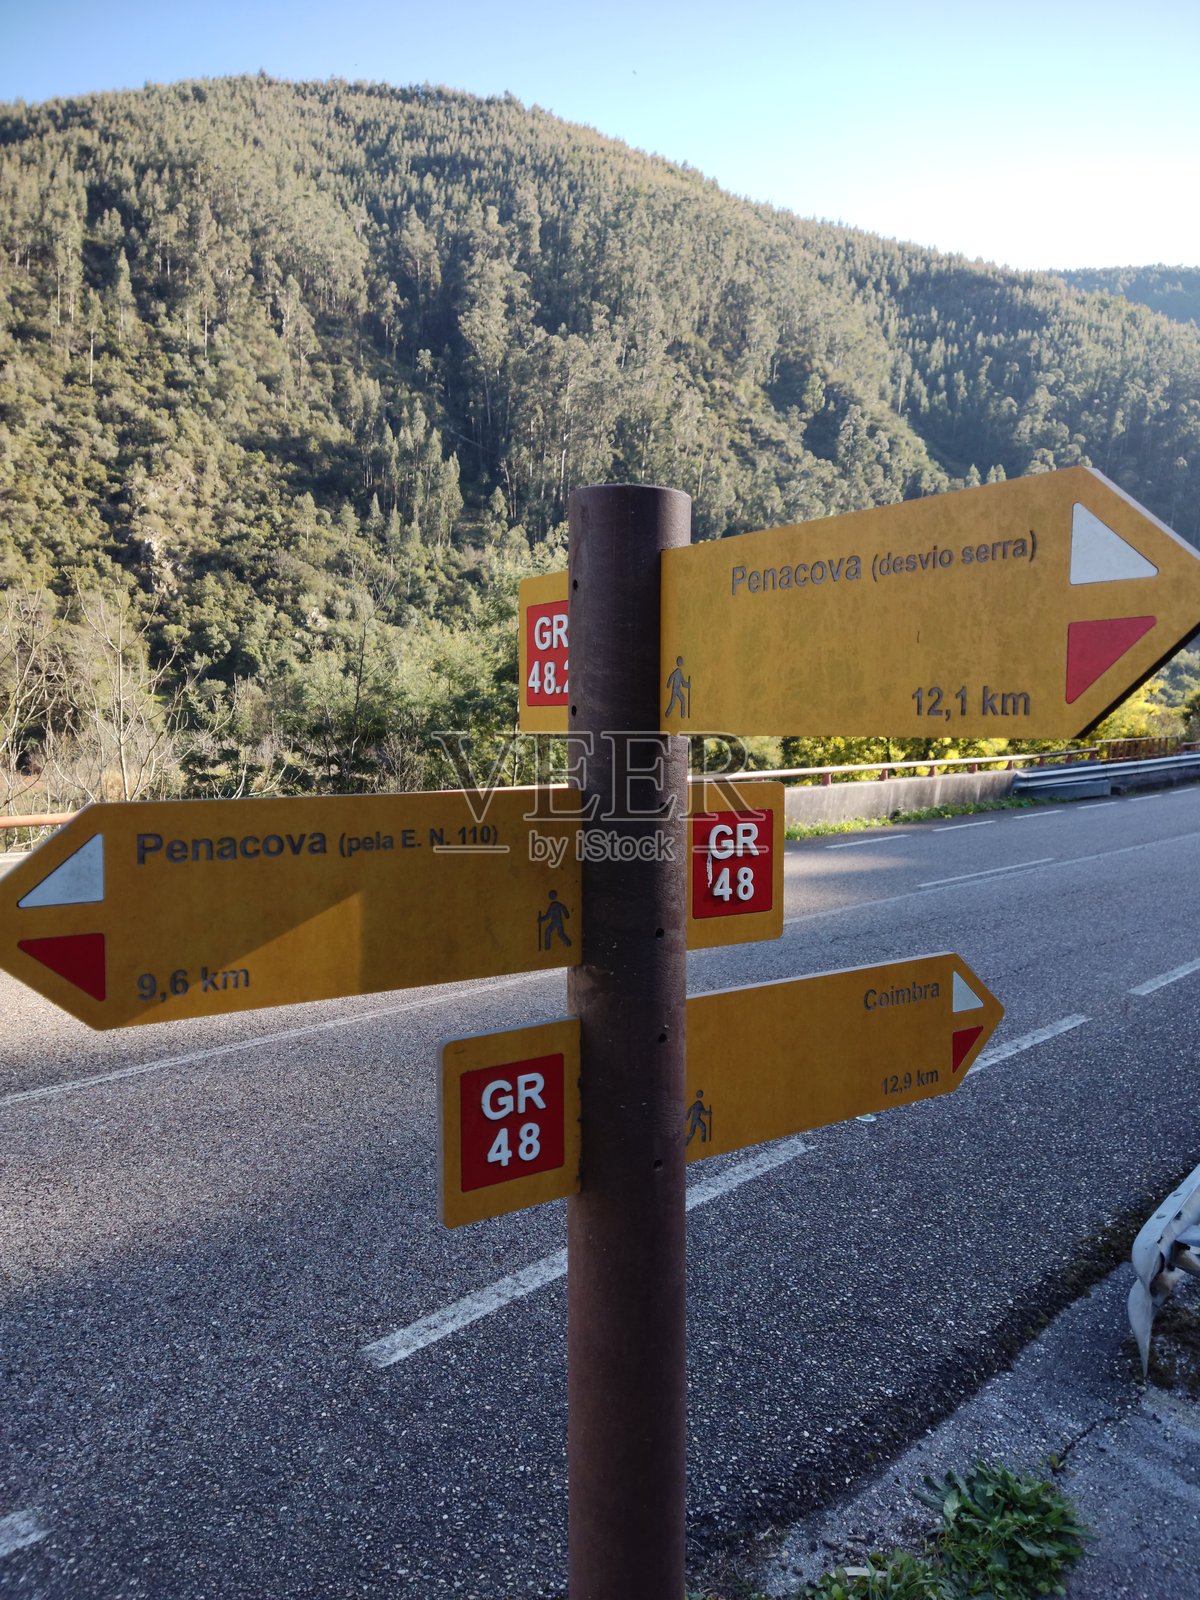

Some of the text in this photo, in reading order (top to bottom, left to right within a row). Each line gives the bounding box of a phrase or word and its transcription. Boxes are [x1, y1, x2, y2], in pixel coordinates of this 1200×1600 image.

[732, 530, 1038, 595] Penacova (desvio serra)
[534, 614, 568, 650] GR
[912, 685, 1031, 721] 12,1 km
[136, 825, 498, 865] Penacova (pela E. N. 110)
[709, 823, 759, 861] GR
[712, 867, 755, 901] 48
[137, 967, 249, 1003] 9,6 km
[863, 981, 940, 1010] Coimbra
[481, 1072, 546, 1121] GR
[882, 1070, 939, 1095] 12,9 km
[486, 1122, 541, 1167] 48
